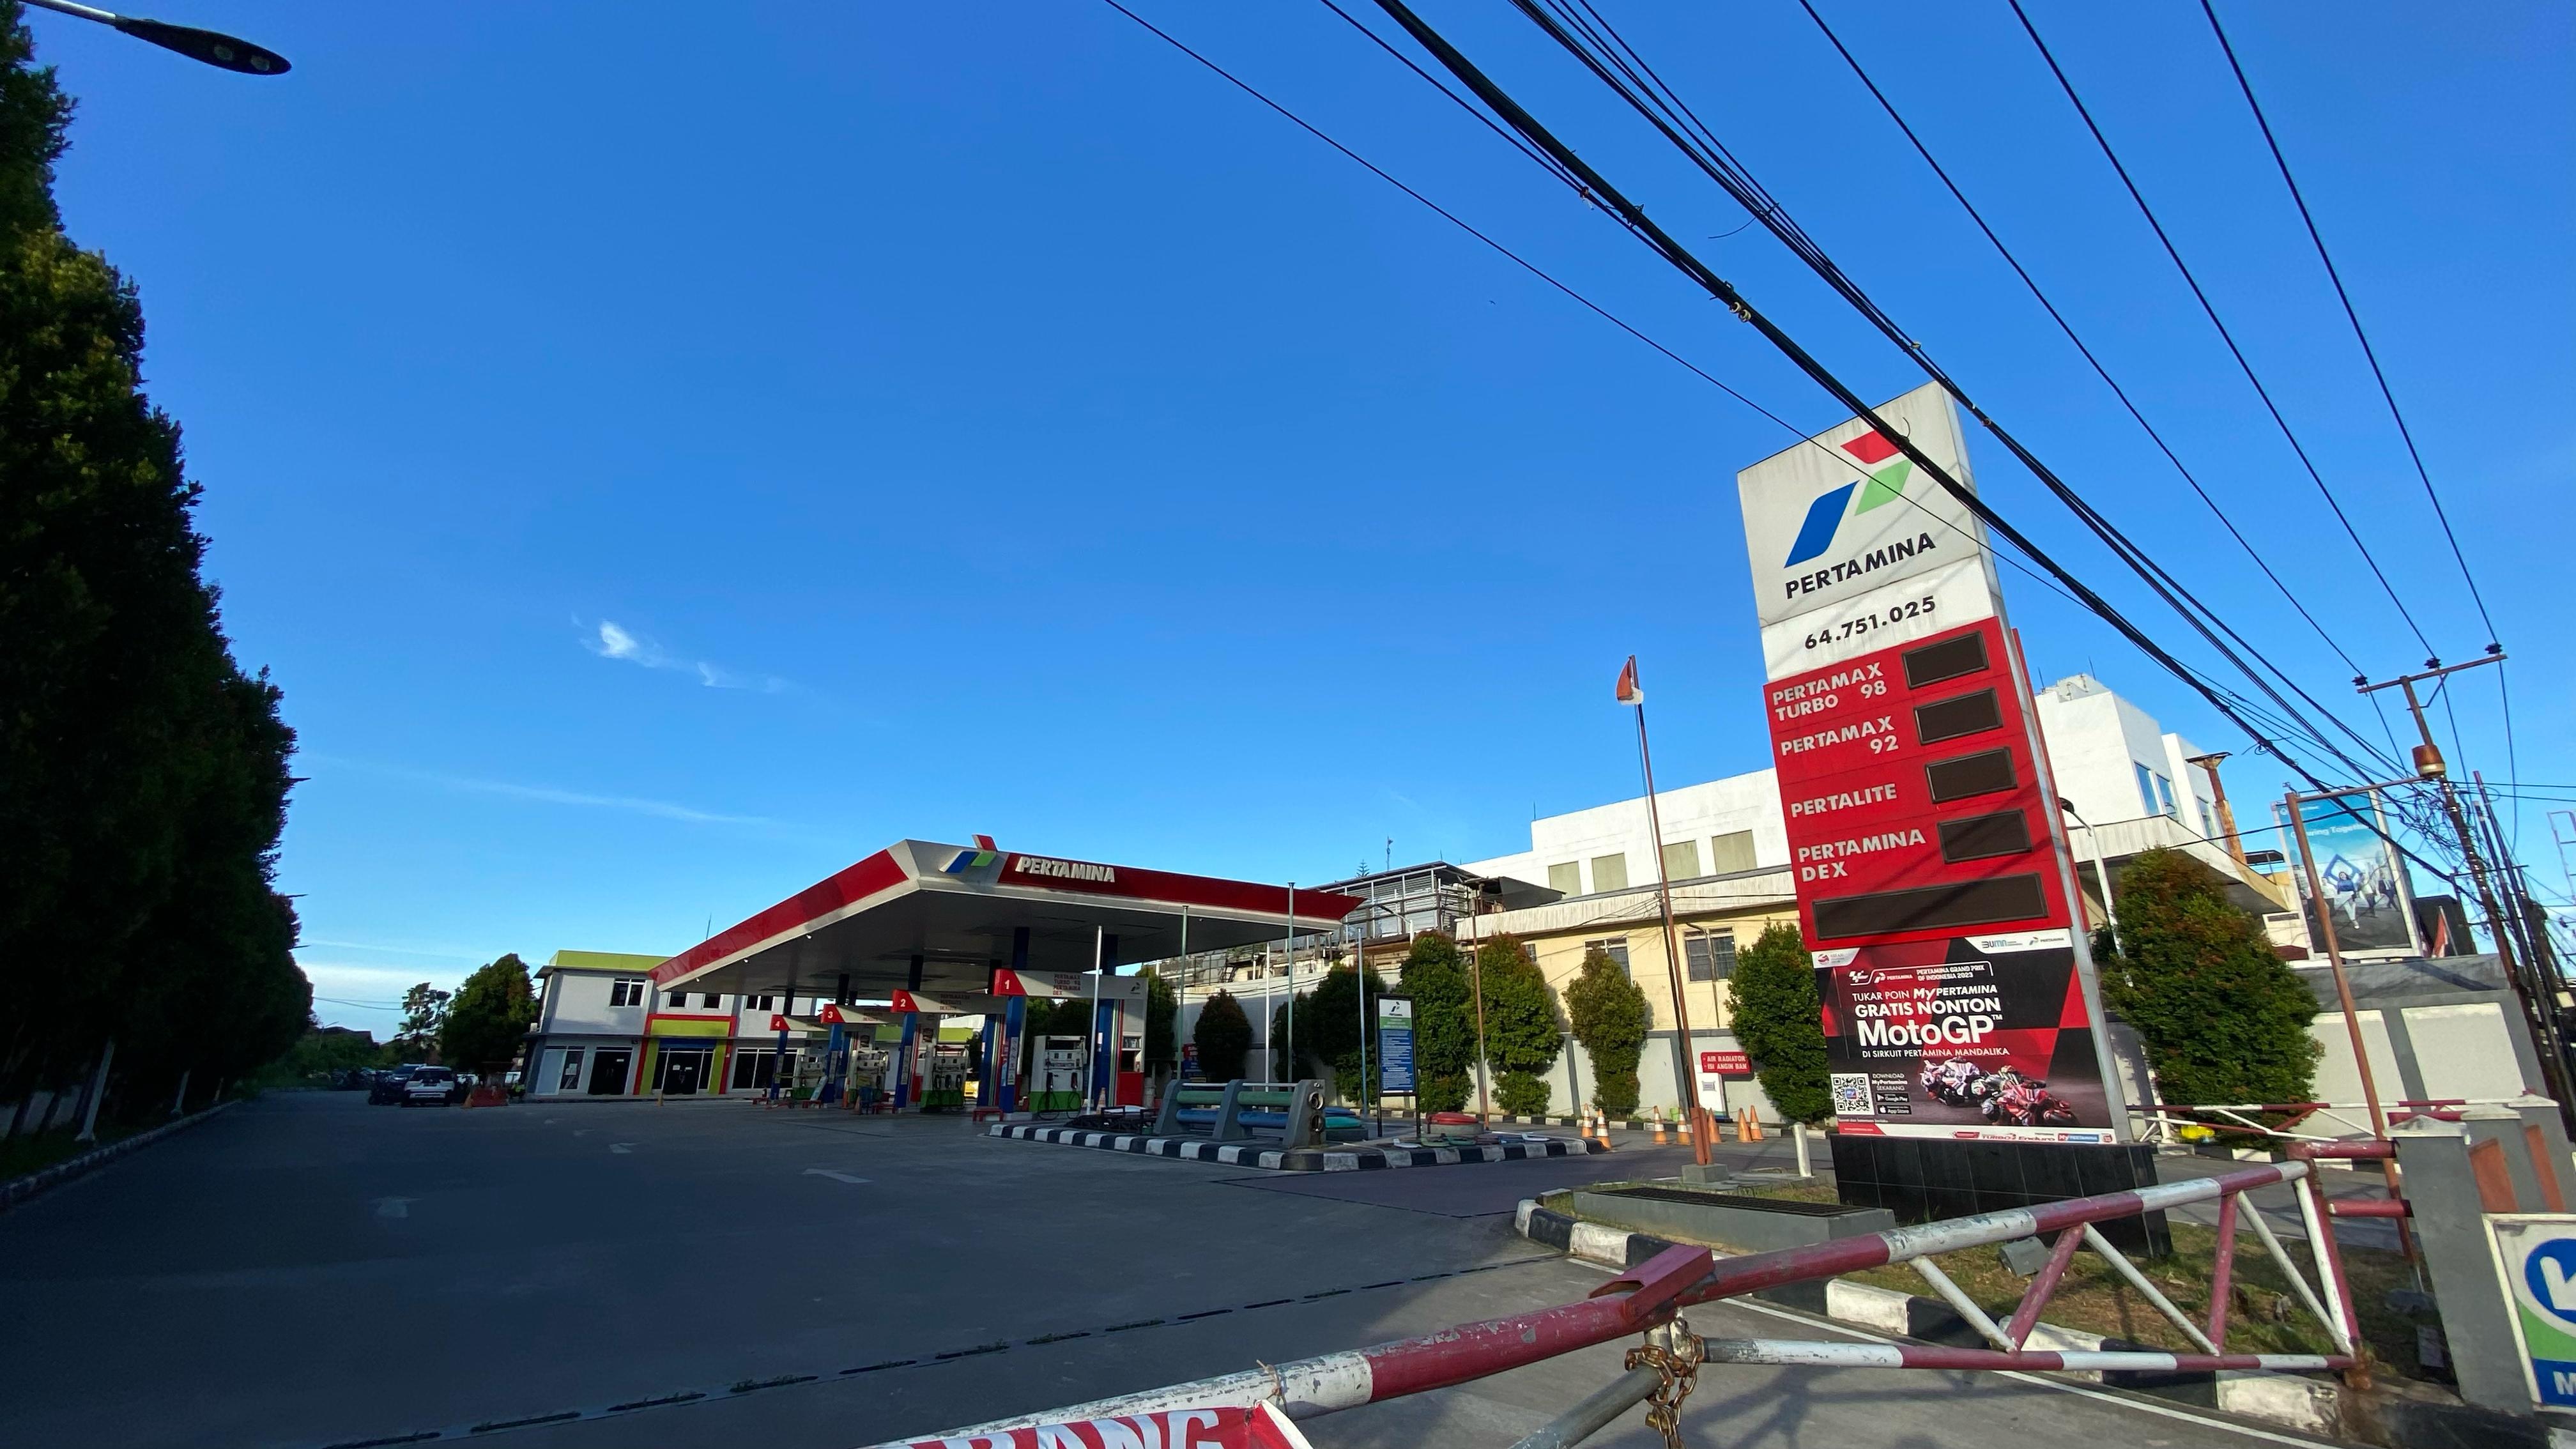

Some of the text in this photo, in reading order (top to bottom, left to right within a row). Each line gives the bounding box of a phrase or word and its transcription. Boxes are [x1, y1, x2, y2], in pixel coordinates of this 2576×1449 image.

[1785, 532, 1936, 599] PERTAMINA
[1805, 595, 1936, 649] 64.751.025
[1772, 662, 1883, 705] PERTAMAX
[1775, 680, 1887, 721] TURBO 98
[1781, 716, 1894, 756] PERTAMAX
[1870, 735, 1899, 755] 92
[1791, 783, 1897, 818] PERTALITE
[1798, 829, 1926, 862] PERTAMINA
[1015, 856, 1115, 882] PERTAMINA
[1802, 861, 1848, 882] DEX
[1916, 967, 1949, 975] PERTAMINA
[1004, 979, 1009, 990] 1
[1852, 992, 1883, 1002] TUKAR
[1885, 990, 1910, 1000] POIN
[900, 999, 906, 1007] 2
[1855, 997, 2002, 1018] GRATIS NONTON
[1905, 1049, 1952, 1057] PERTAMINA
[1955, 1048, 2010, 1056] MANDALIKA
